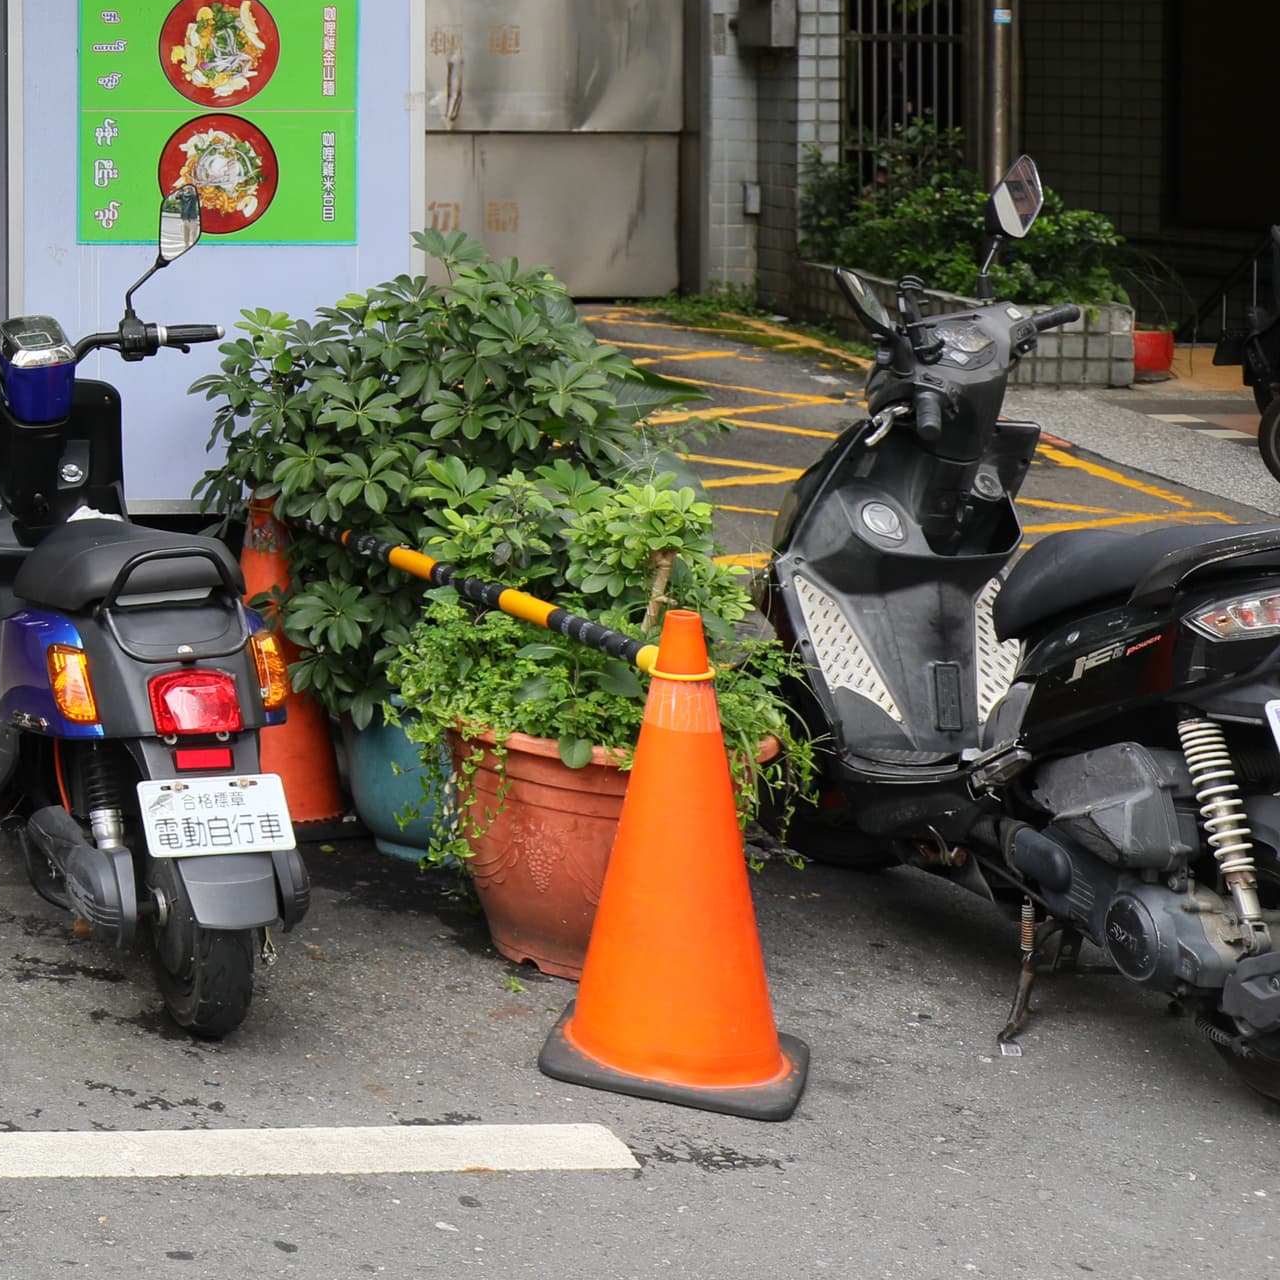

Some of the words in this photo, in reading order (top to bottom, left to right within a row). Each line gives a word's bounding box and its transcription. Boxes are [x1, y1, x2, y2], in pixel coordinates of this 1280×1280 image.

[181, 790, 247, 810] 合格標章
[154, 811, 285, 850] 電動自行車
